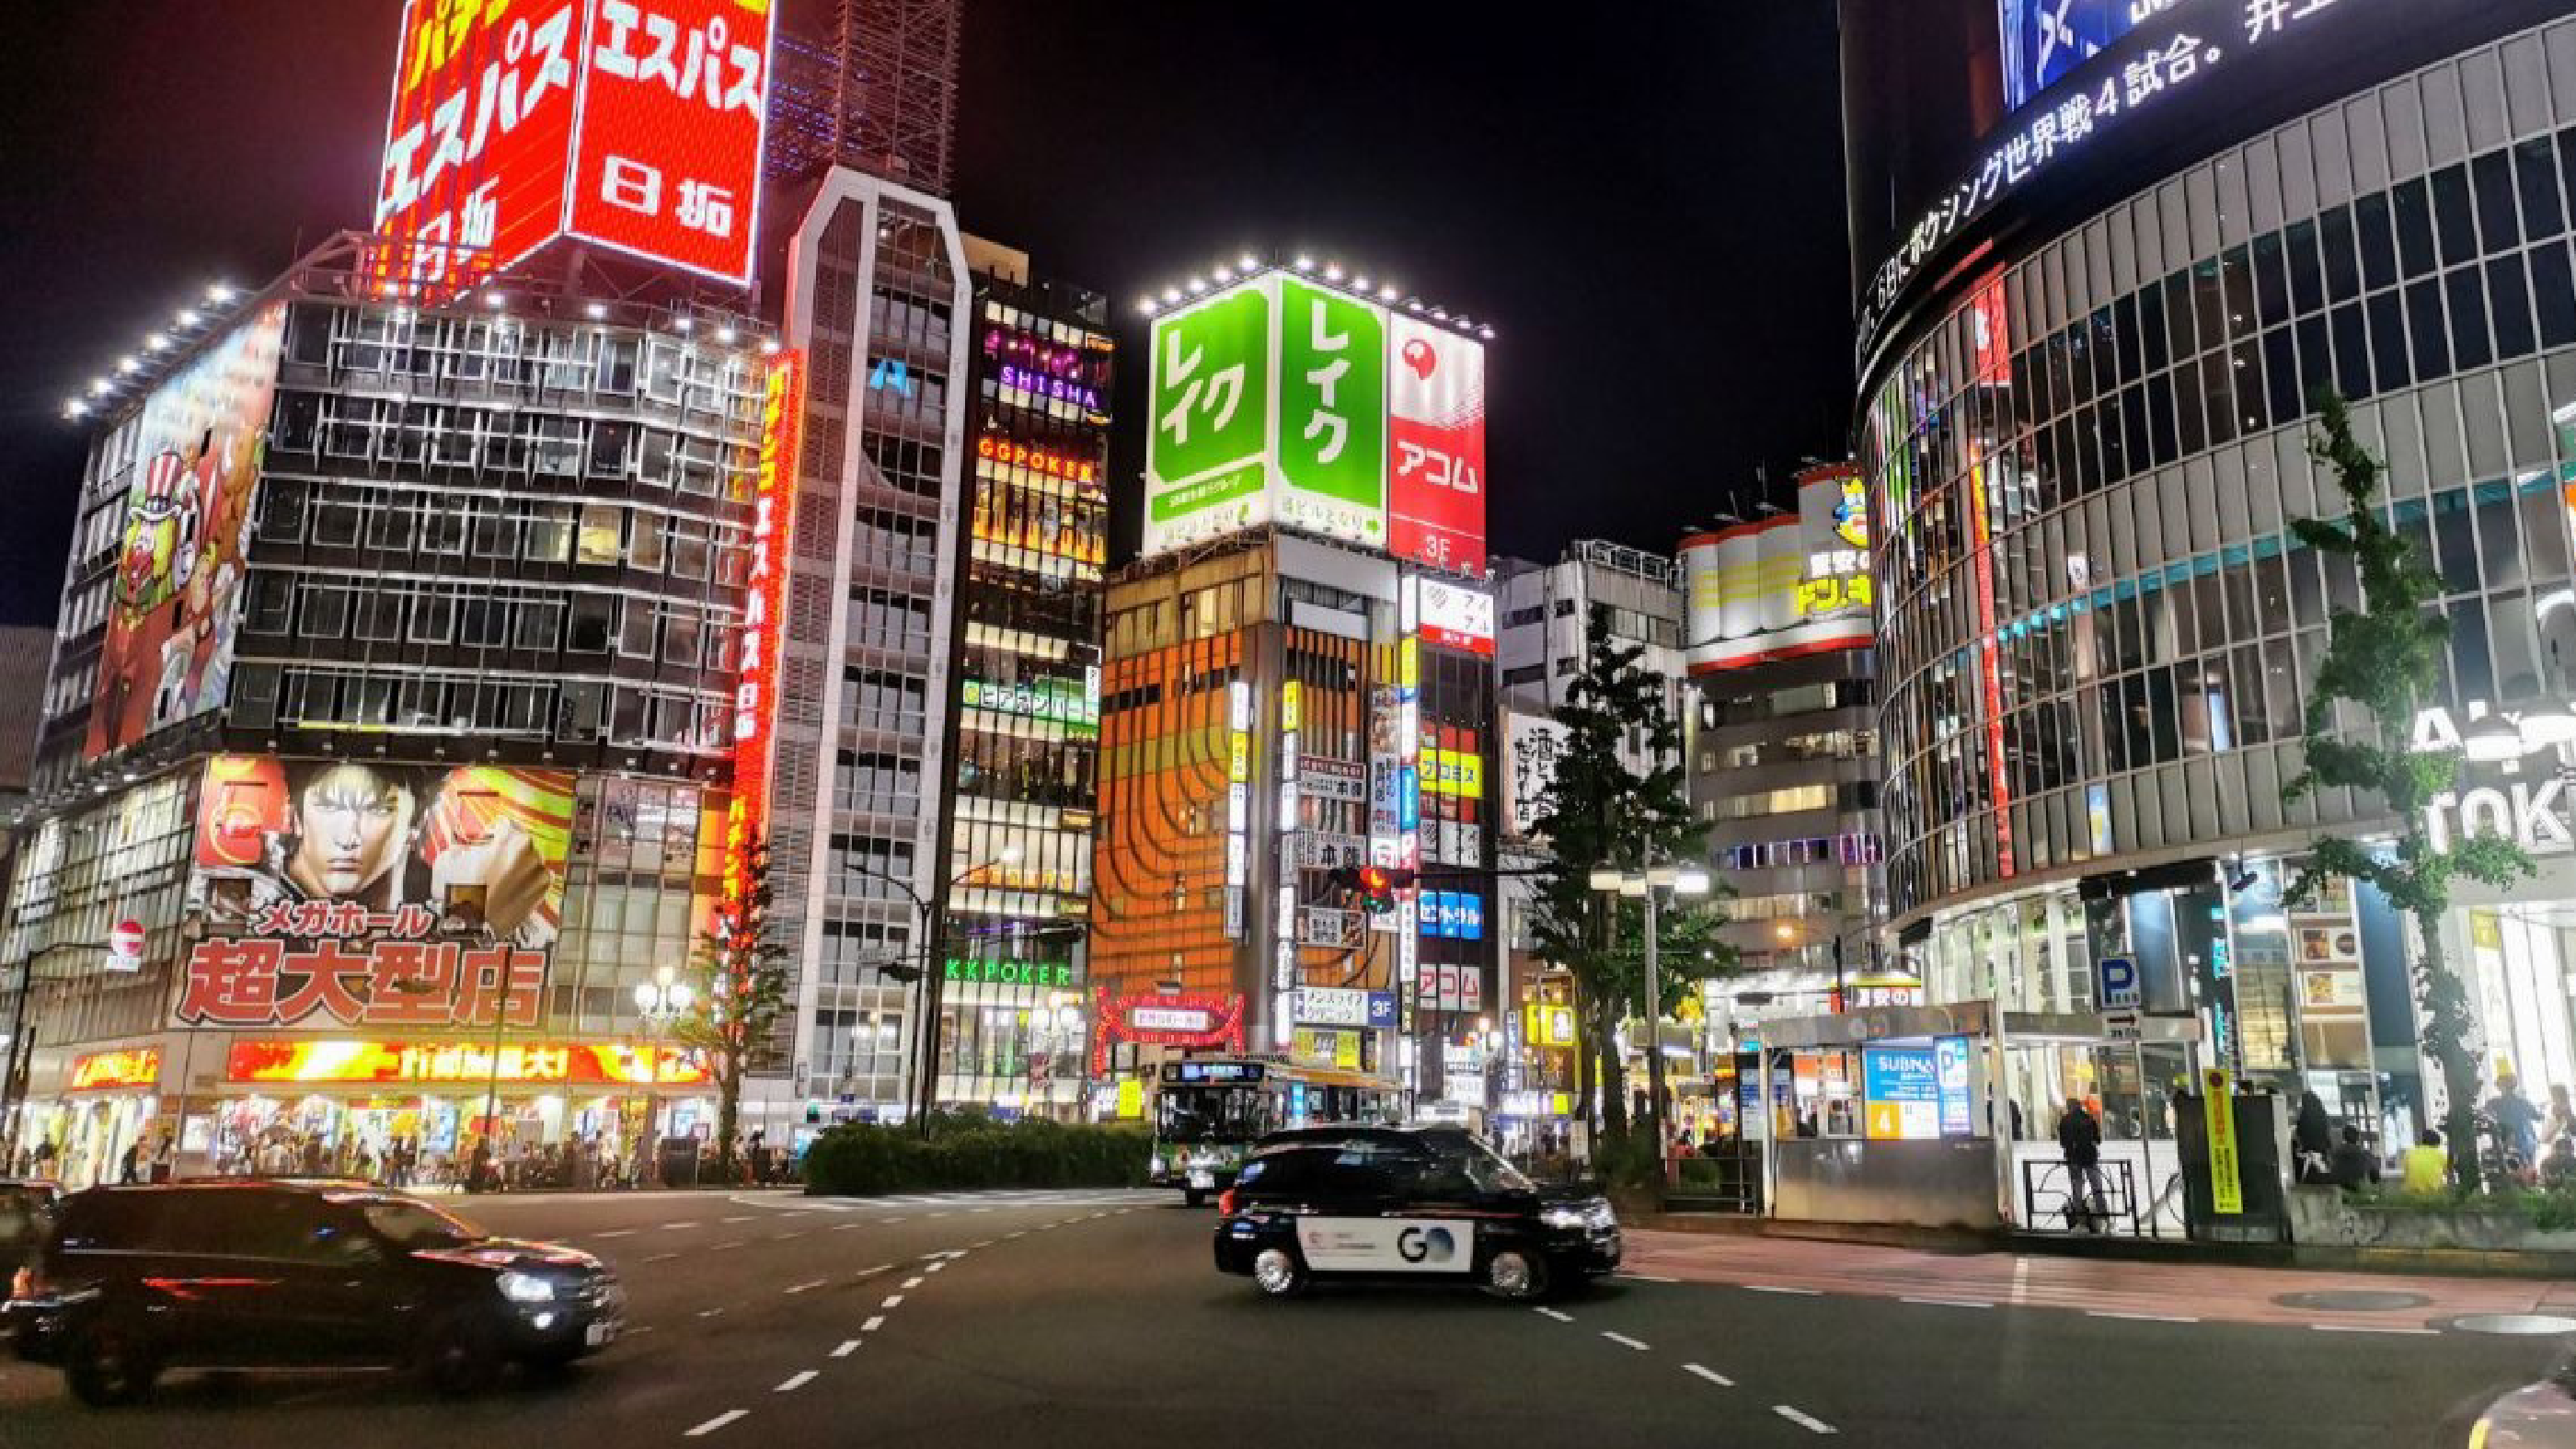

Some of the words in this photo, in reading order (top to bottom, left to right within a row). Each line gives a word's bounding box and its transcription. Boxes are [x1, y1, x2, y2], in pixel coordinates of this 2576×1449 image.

[594, 3, 763, 120] エスパス
[383, 4, 574, 217] エスパス
[1001, 365, 1097, 408] SHISHA
[1161, 328, 1245, 445] レイク
[1304, 300, 1351, 464] レイク
[978, 437, 1093, 481] GGPOKER
[1397, 440, 1479, 494] アコム
[1425, 535, 1451, 558] 3F
[253, 901, 433, 937] メガホール
[179, 937, 547, 1027] 超大型店
[945, 958, 1071, 986] KKPOKER
[1419, 970, 1478, 997] アコム
[2101, 959, 2135, 1005] P
[1371, 999, 1393, 1018] 3F
[1397, 1226, 1455, 1263] GO
